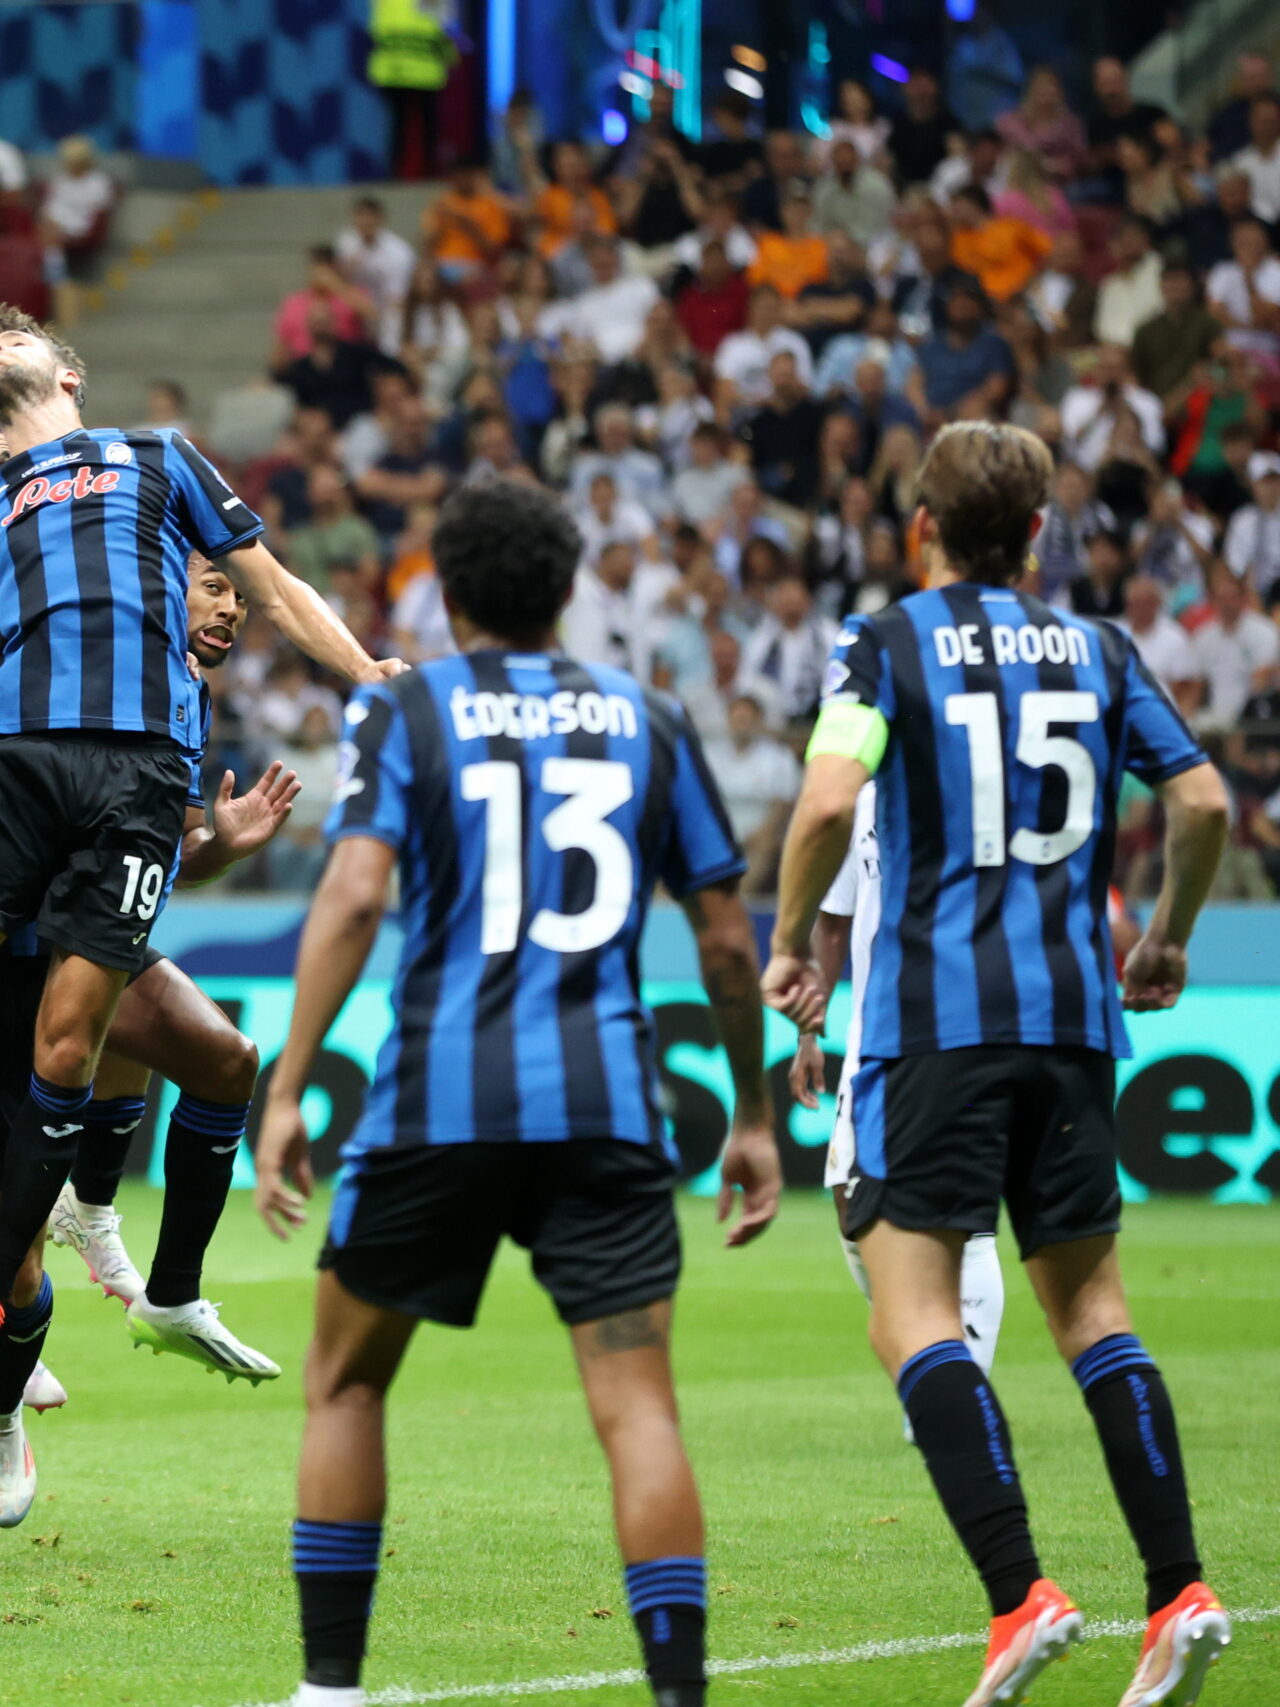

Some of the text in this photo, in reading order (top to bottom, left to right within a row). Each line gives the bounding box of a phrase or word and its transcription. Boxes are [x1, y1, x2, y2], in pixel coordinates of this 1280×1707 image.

[932, 624, 1090, 667] DE ROON
[450, 685, 638, 742] ÉDERSON
[944, 691, 1099, 868] 15
[120, 855, 164, 920] 19
[461, 757, 634, 955] 13
